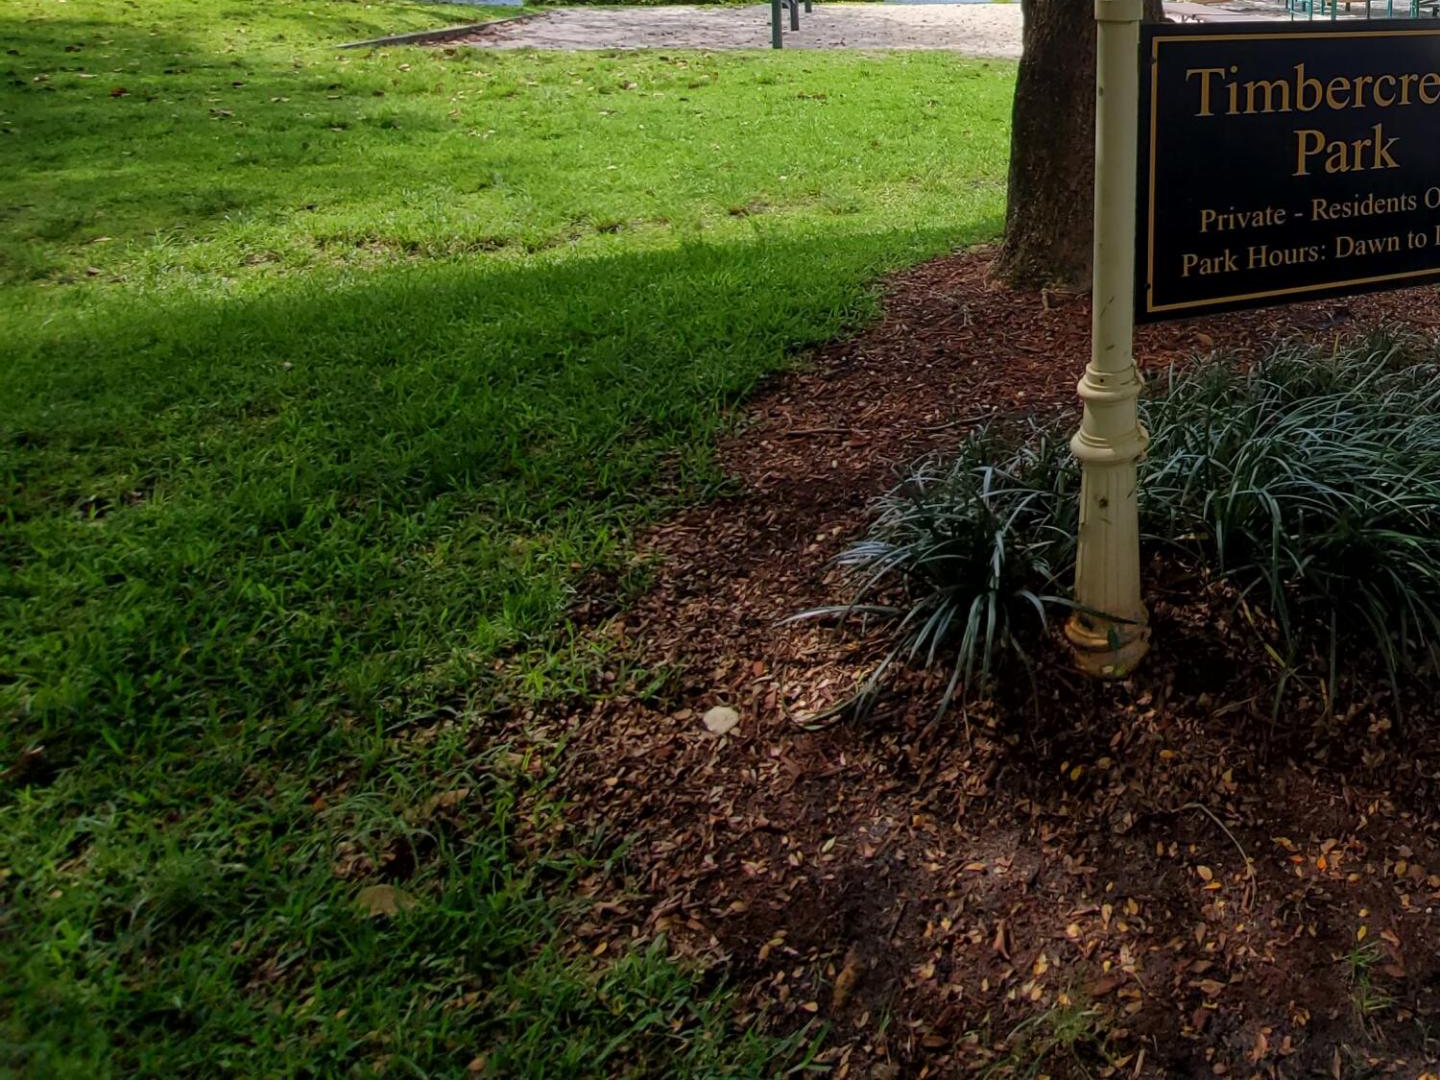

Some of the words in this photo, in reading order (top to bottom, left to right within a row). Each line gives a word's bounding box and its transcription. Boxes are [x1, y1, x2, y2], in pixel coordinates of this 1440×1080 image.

[1292, 123, 1400, 176] Park
[1200, 206, 1286, 233] Private
[1311, 193, 1417, 221] Residents
[1181, 250, 1238, 278] Park
[1247, 245, 1326, 270] Hours:
[1335, 236, 1400, 258] Dawn
[1407, 231, 1427, 248] to
